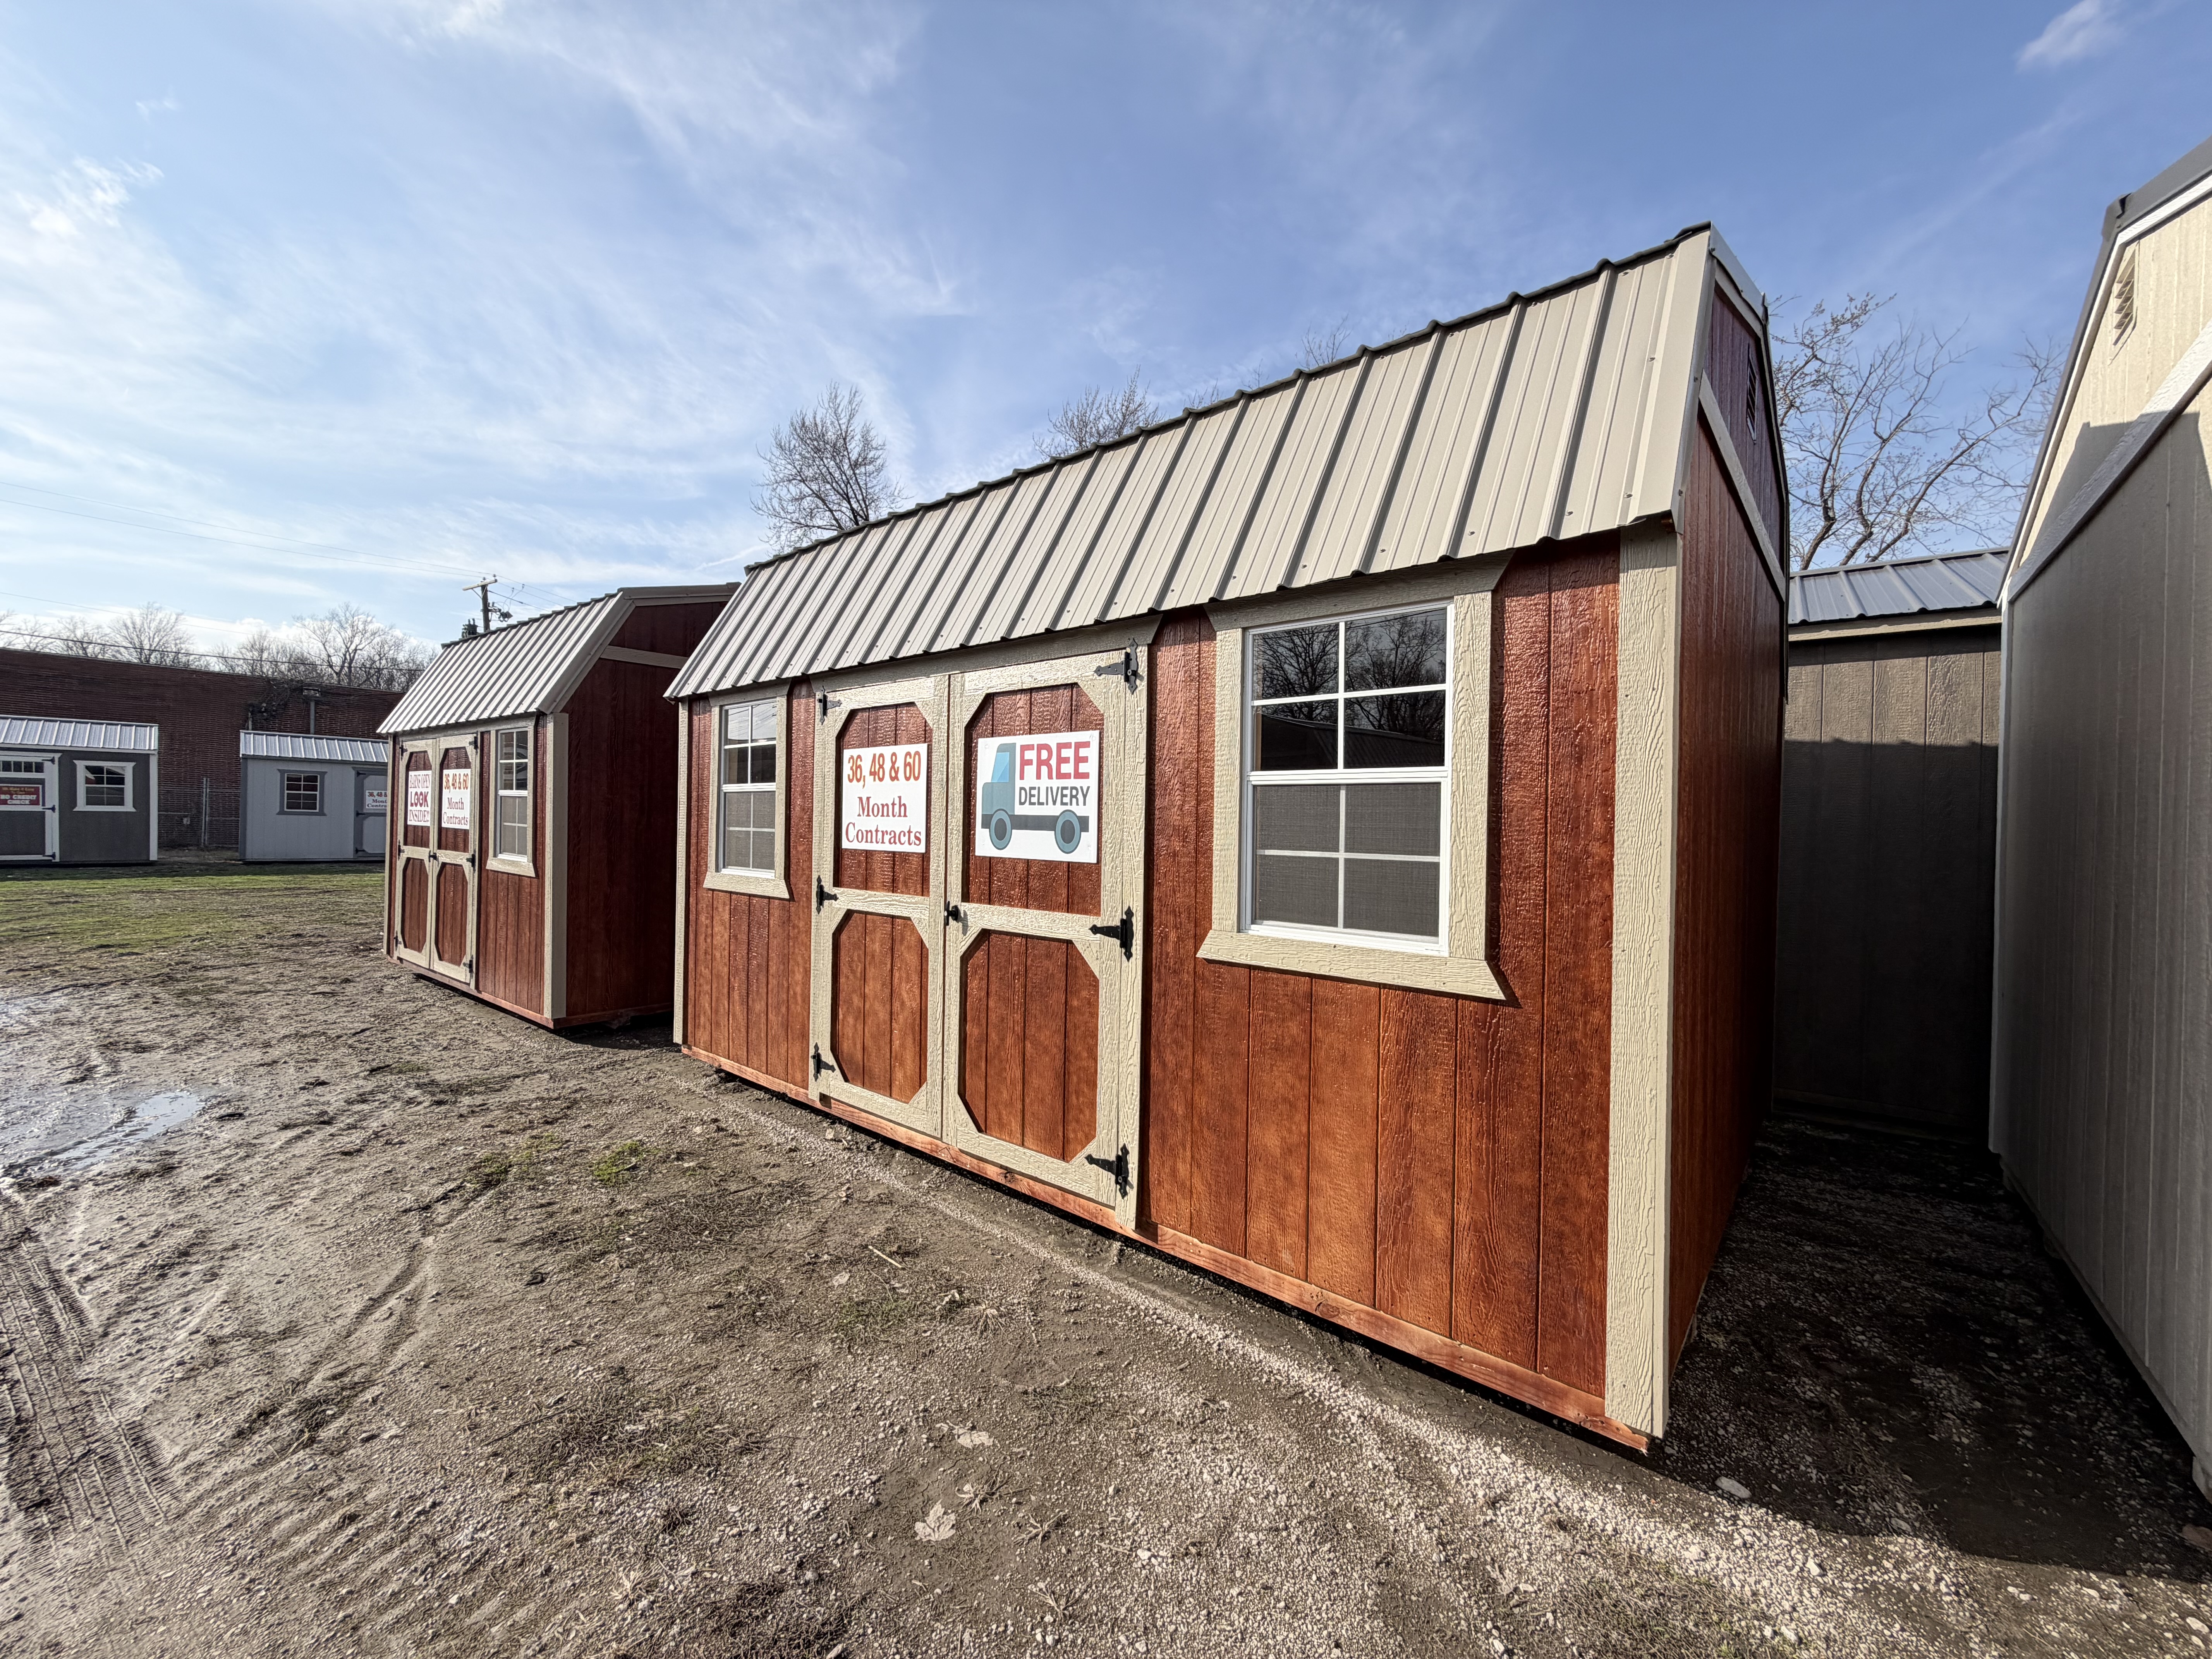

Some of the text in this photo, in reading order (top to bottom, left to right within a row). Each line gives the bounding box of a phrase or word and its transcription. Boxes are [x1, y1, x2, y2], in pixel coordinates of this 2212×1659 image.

[847, 750, 921, 789] 36, 48 & 60
[1019, 741, 1090, 780] FREE
[452, 773, 457, 790] 48
[458, 773, 462, 790] &
[463, 773, 469, 790] 60
[410, 791, 429, 807] LOOK
[447, 797, 464, 810] Month
[1018, 786, 1090, 806] DELIVERY
[857, 796, 908, 818] Month
[443, 812, 468, 826] Contracts
[845, 822, 921, 846] Contracts
